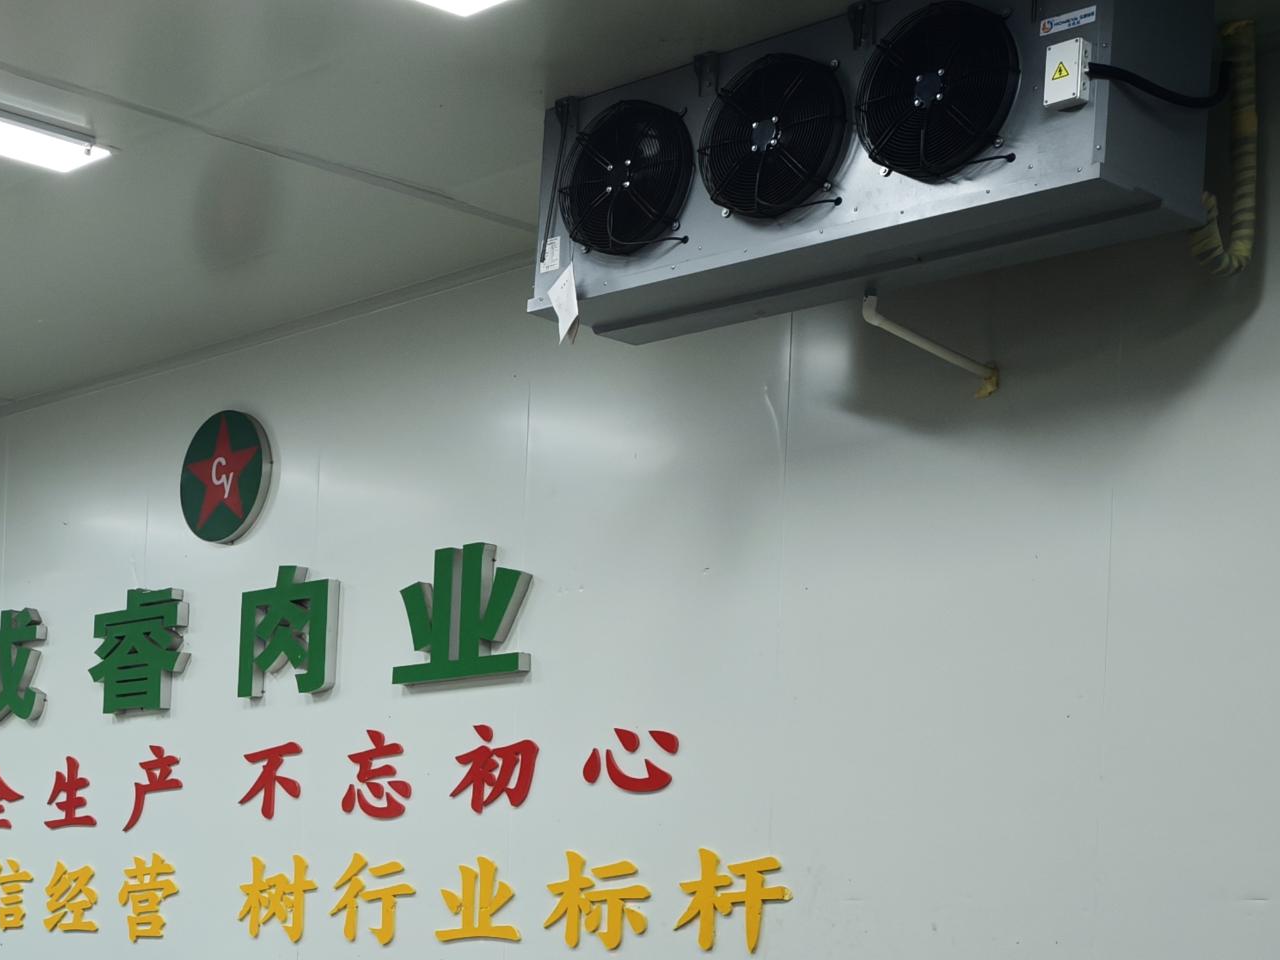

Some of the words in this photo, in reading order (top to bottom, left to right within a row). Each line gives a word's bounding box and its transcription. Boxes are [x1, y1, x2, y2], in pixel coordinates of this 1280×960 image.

[239, 724, 681, 820] 不忘初心
[238, 847, 791, 955] 树行业标杆
